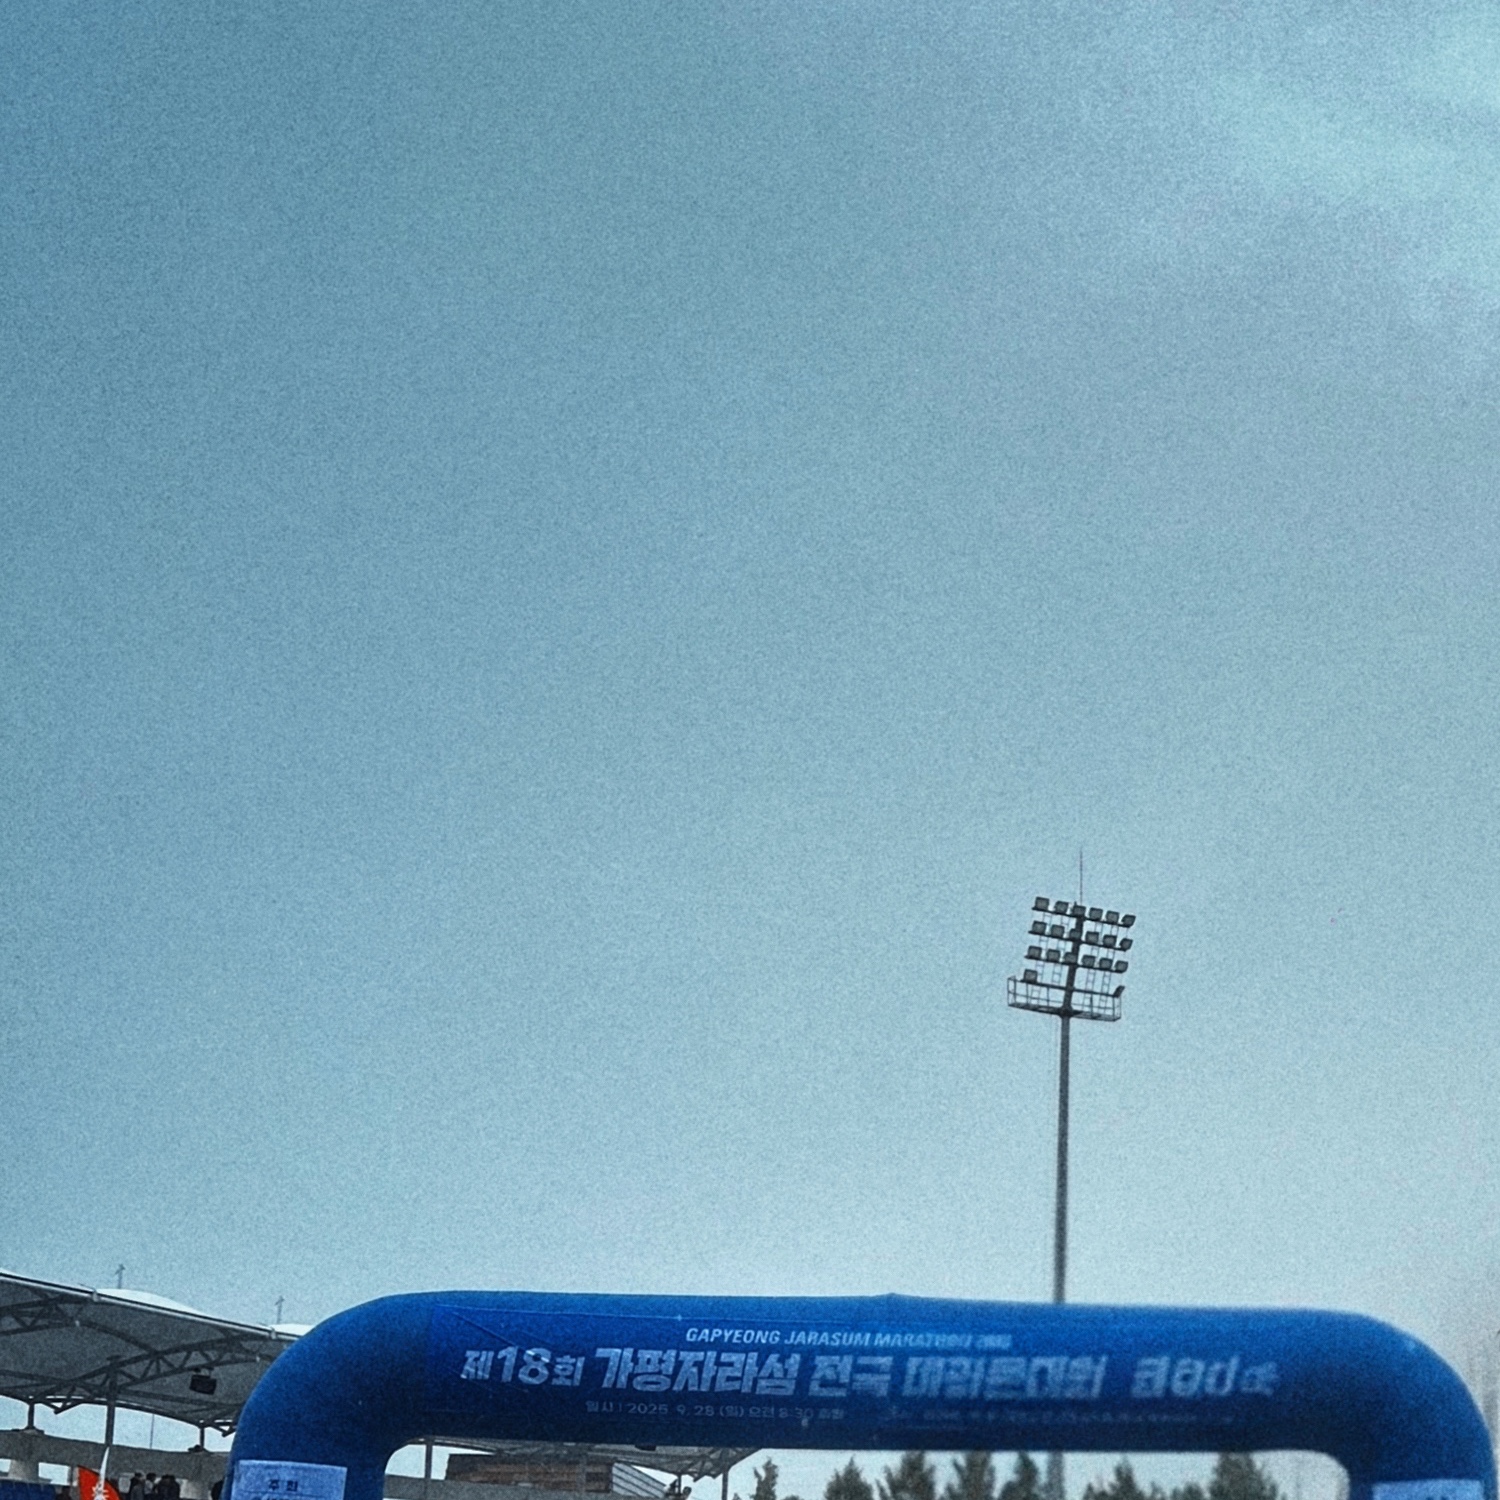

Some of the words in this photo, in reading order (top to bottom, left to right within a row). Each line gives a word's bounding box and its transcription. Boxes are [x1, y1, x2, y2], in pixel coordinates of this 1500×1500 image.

[685, 1327, 780, 1344] GAPYEONG
[783, 1330, 871, 1347] JARASUM
[460, 1345, 586, 1387] 제18회
[595, 1347, 801, 1396] 가평자라섬
[807, 1355, 894, 1397] 전국
